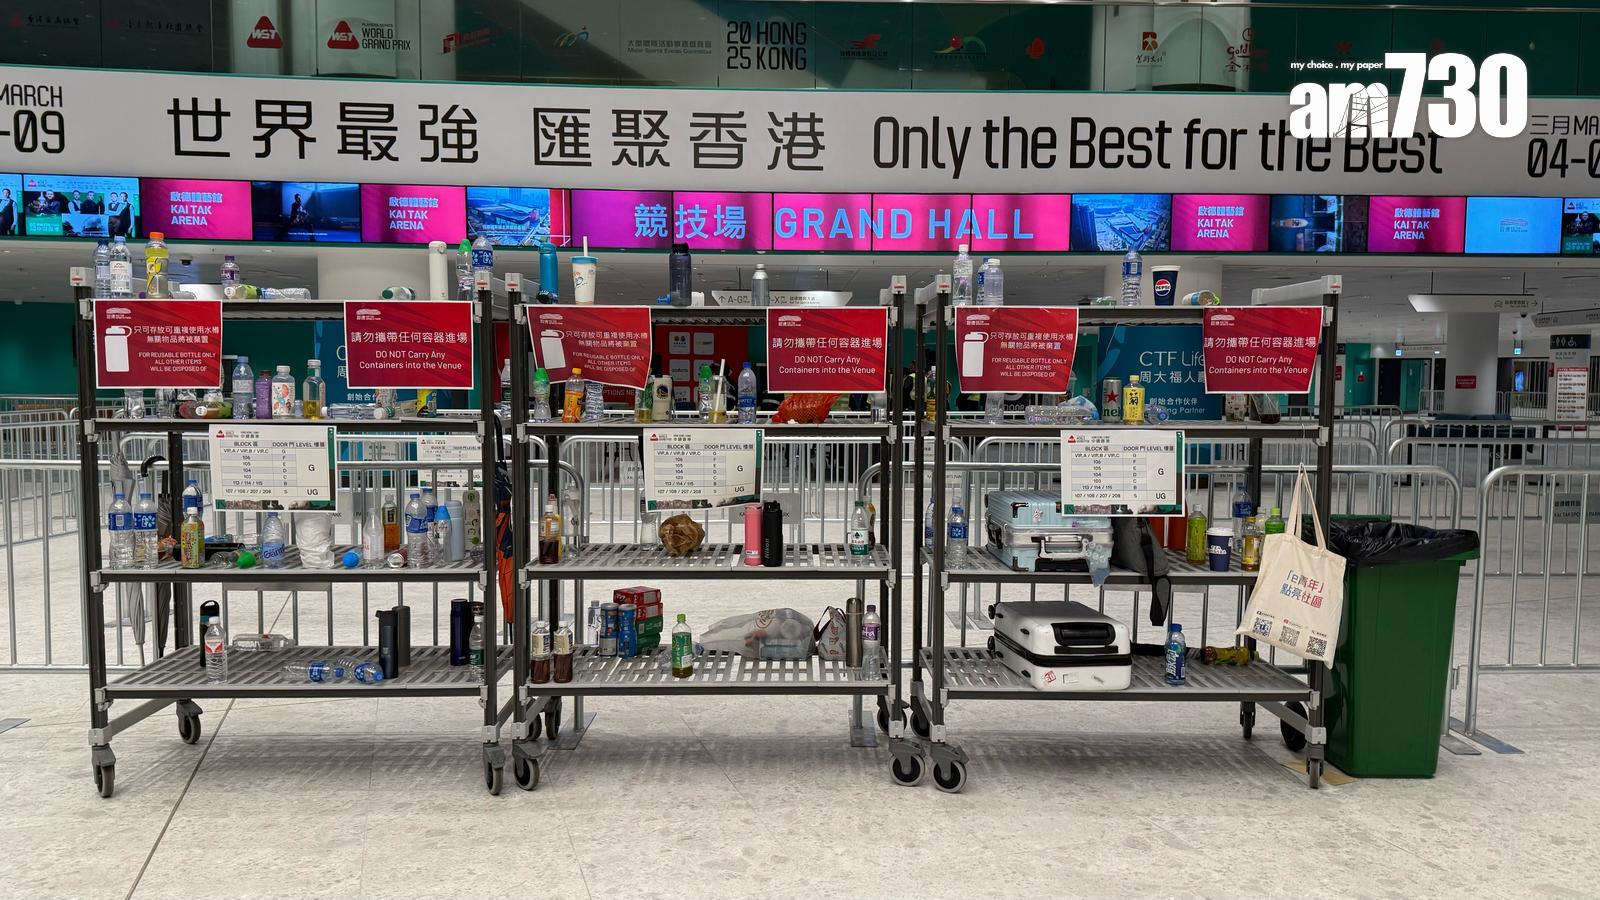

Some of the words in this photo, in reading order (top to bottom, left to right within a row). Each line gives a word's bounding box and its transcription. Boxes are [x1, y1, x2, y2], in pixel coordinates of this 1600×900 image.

[362, 28, 393, 38] WORLD
[727, 21, 750, 44] 20
[757, 22, 806, 44] HONG
[362, 39, 390, 49] GRAND
[392, 40, 411, 50] PRIX
[727, 47, 750, 69] 25
[757, 47, 806, 70] KONG
[1530, 115, 1570, 135] 三月
[167, 97, 478, 163] 世界最強
[534, 107, 825, 171] 匯聚香港
[874, 116, 972, 179] Only
[982, 117, 1057, 169] the
[1070, 117, 1172, 170] Best
[1184, 118, 1248, 171] for
[1261, 119, 1331, 173] the
[1343, 130, 1443, 175] Best
[171, 205, 190, 215] KAI
[192, 206, 212, 216] TAK
[389, 210, 408, 220] KAI
[410, 211, 429, 220] TAK
[171, 216, 208, 226] ARENA
[389, 221, 424, 230] ARENA
[634, 204, 747, 239] 競技場
[775, 207, 913, 239] GRAND
[930, 208, 1034, 239] HALL
[1197, 219, 1215, 228] KAI
[1217, 219, 1234, 228] TAK
[1394, 221, 1411, 230] KAI
[1413, 221, 1429, 230] TAK
[1197, 230, 1229, 238] ARENA
[1394, 231, 1425, 239] ARENA
[351, 332, 468, 343] 請勿攜帶任何容器進場
[772, 338, 883, 348] 請勿攜帶任何容器進場
[1204, 337, 1316, 348] 請勿攜帶任何容器進場
[408, 351, 429, 360] Carry
[431, 351, 445, 359] Any
[794, 356, 805, 364] DO
[807, 356, 822, 364] NOT
[825, 356, 845, 365] Carry
[847, 356, 860, 365] Any
[1140, 351, 1177, 366] CTF
[1182, 351, 1205, 366] Life
[1257, 356, 1276, 365] Carry
[1278, 356, 1292, 365] Any
[779, 366, 819, 374] Containers
[838, 366, 850, 374] the
[1129, 392, 1138, 405] 菊
[1287, 570, 1324, 593] 「e青年」
[1280, 583, 1323, 608] 點亮社區
